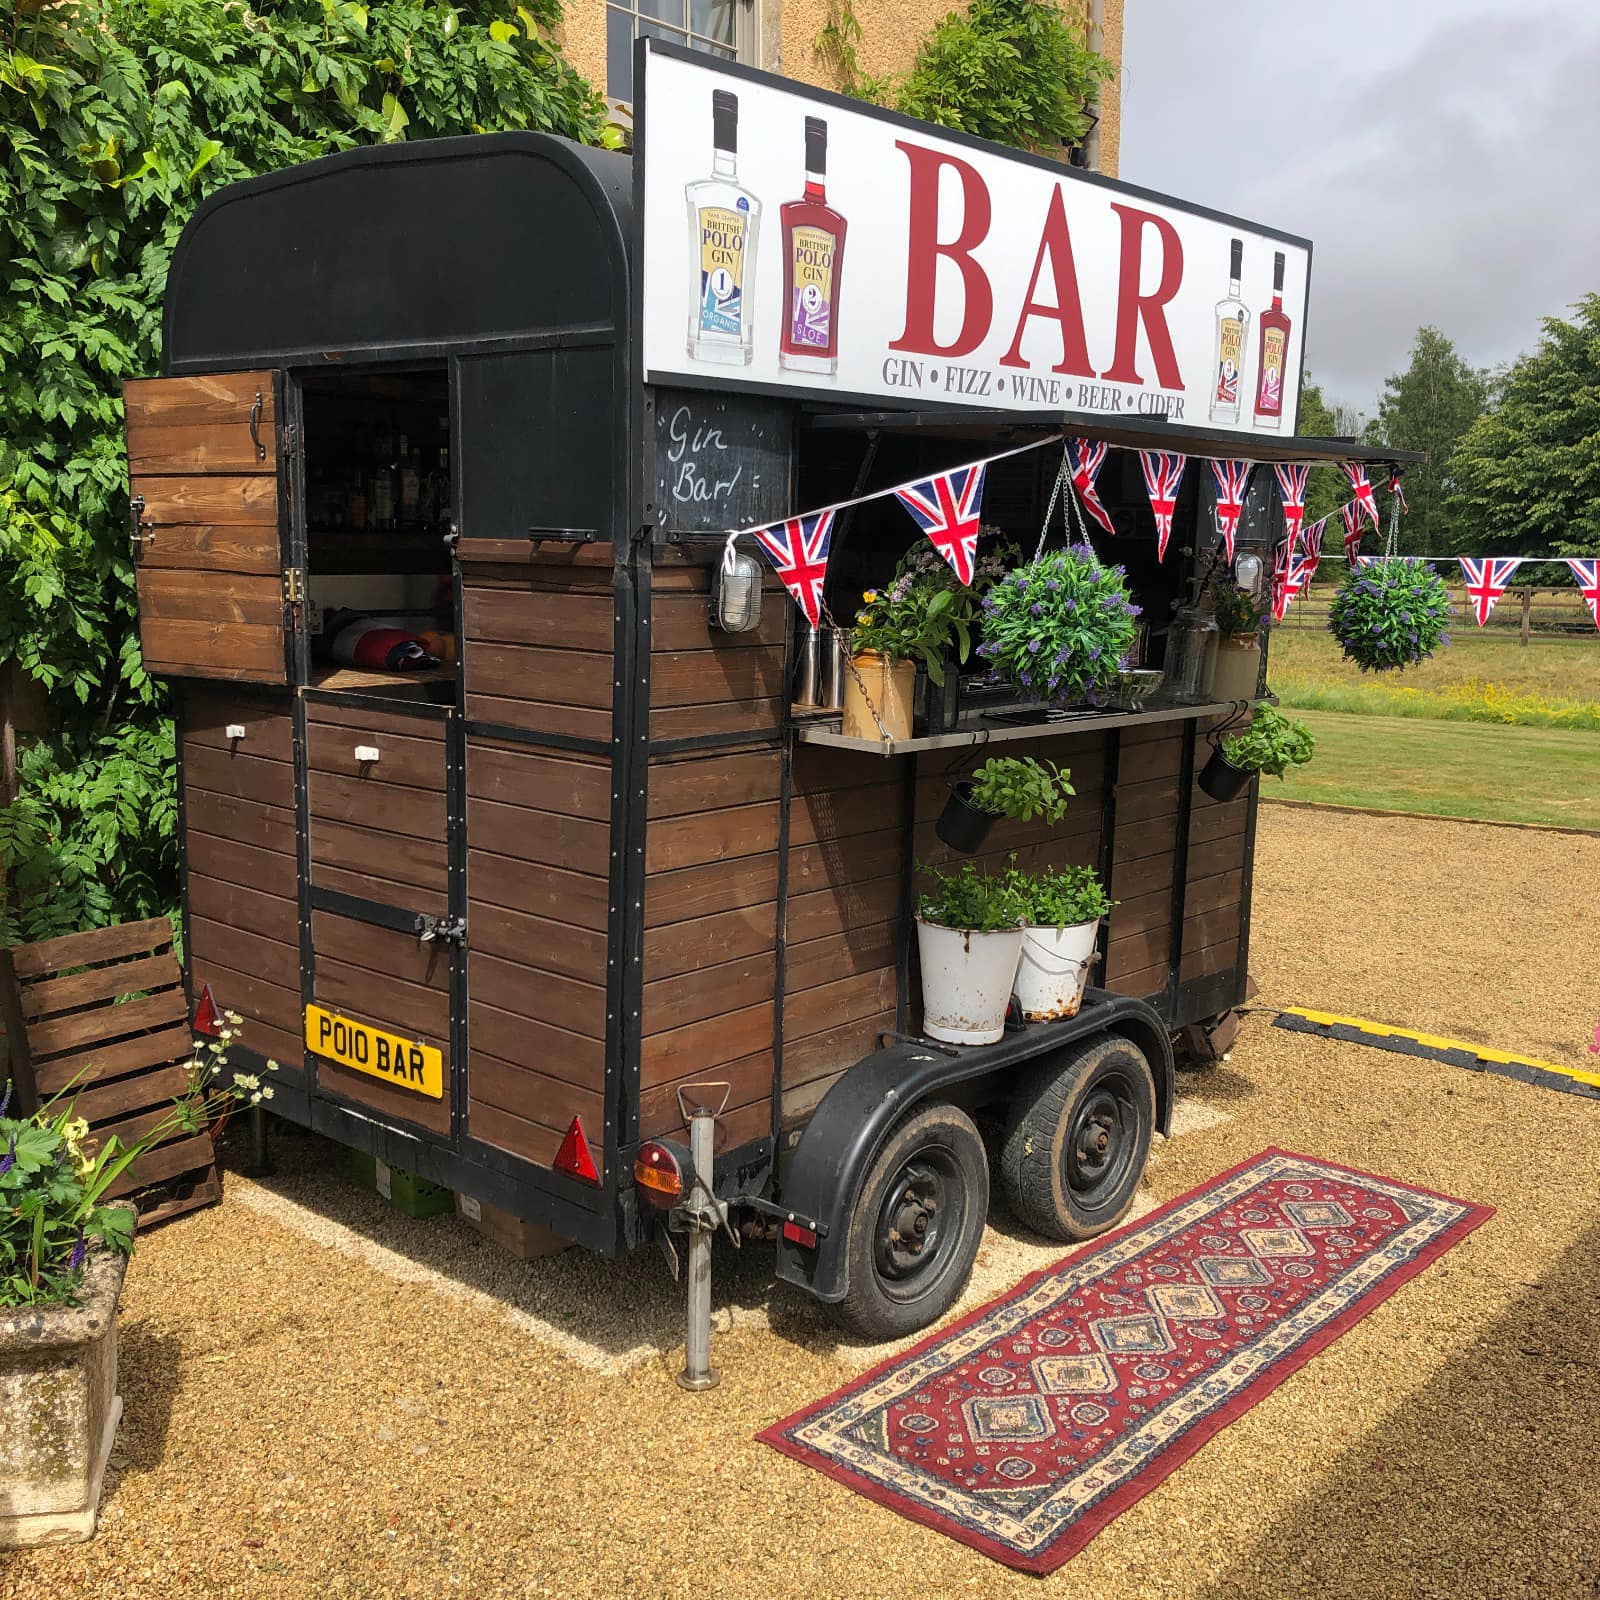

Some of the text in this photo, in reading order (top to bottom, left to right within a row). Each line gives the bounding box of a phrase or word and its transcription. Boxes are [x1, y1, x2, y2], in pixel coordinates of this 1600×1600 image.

[707, 219, 740, 235] BRITISH
[703, 229, 743, 252] POLO
[711, 249, 734, 265] GIN
[796, 247, 832, 269] POLO
[888, 139, 1186, 391] BAR
[719, 271, 725, 291] 1
[803, 266, 823, 282] GIN
[808, 288, 817, 306] 2
[702, 310, 739, 332] ORGANIC
[796, 323, 822, 344] SLOE
[1222, 333, 1241, 348] POLO
[882, 357, 1185, 420] GIN FIZZ WINE BEER CIDER
[667, 405, 728, 463] Gin
[375, 1036, 425, 1086] BAR
